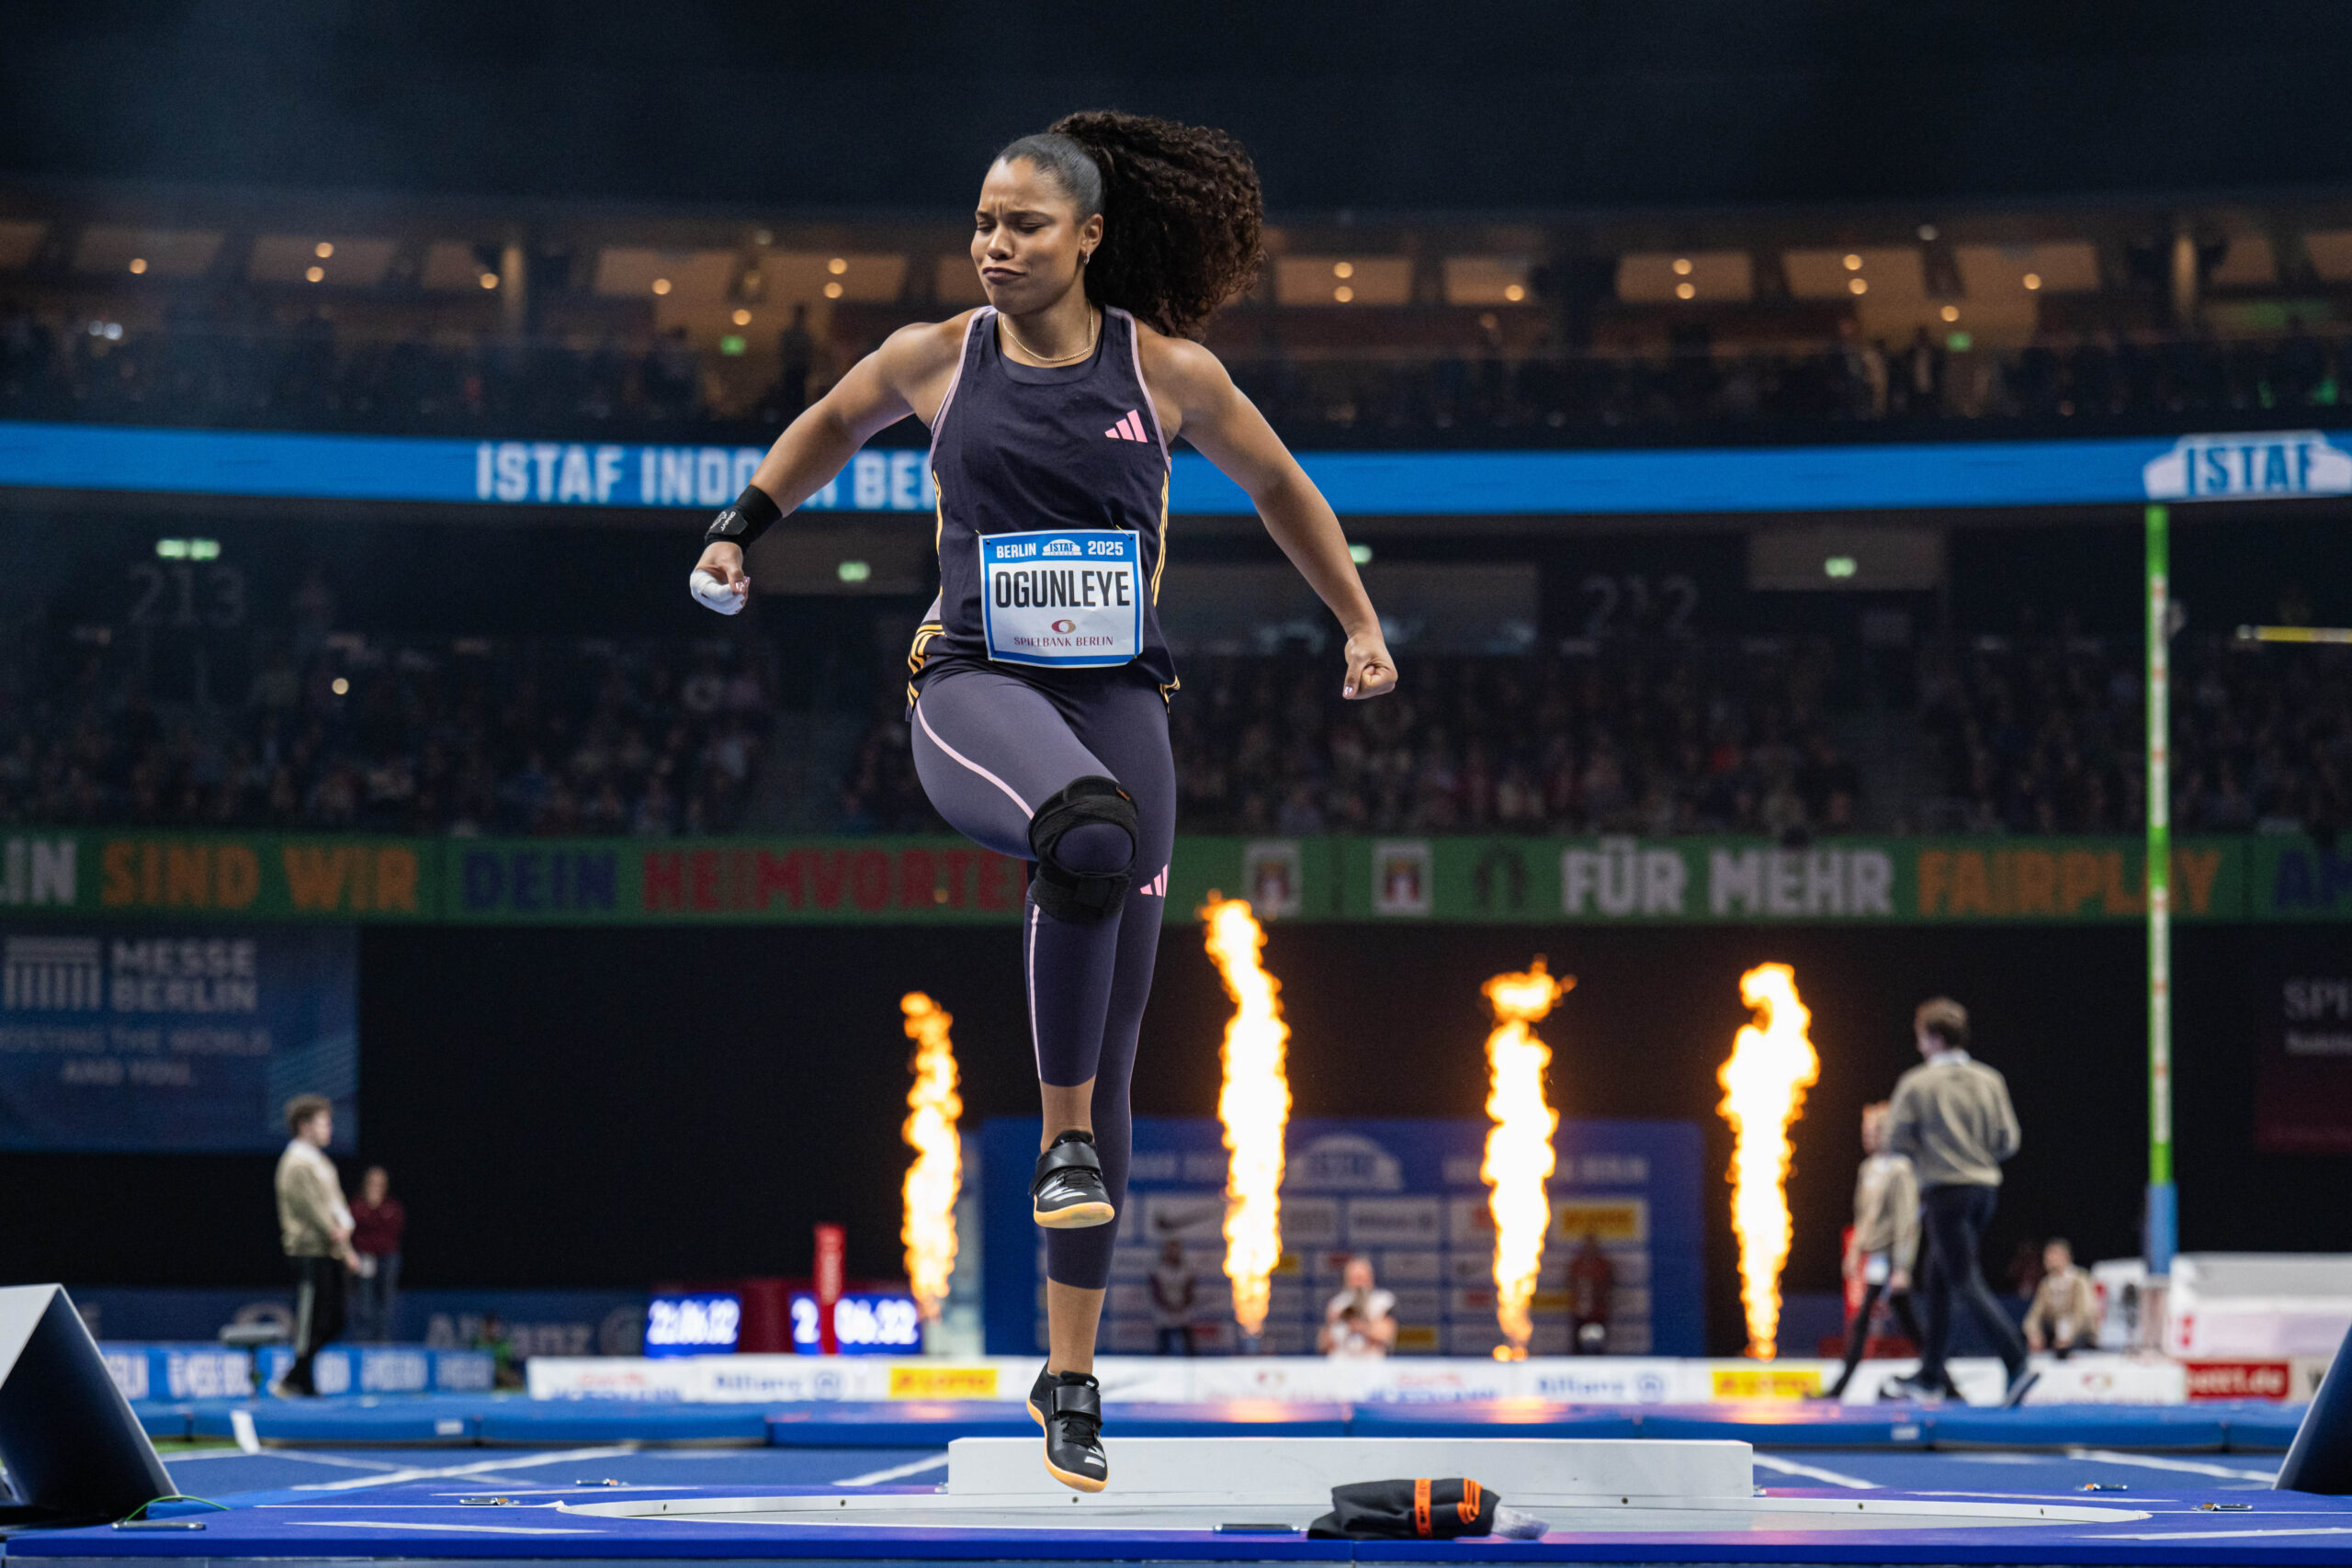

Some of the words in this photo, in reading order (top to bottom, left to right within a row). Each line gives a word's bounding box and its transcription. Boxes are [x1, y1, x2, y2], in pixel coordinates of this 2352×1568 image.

[476, 443, 624, 502] ISTAF
[2187, 445, 2311, 496] ISTAF
[996, 542, 1037, 558] BERLIN
[1087, 540, 1124, 556] 2025
[995, 570, 1130, 608] OGUNLEYE
[1013, 637, 1072, 648] SPIELBANK
[1076, 636, 1114, 647] BERLIN
[102, 840, 261, 909] SIND
[283, 845, 420, 912] WIR
[464, 848, 617, 910] DEIN
[1563, 836, 1688, 917] FÜR
[1710, 848, 1894, 917] MEHR
[112, 938, 256, 976] MESSE
[111, 977, 256, 1011] BERLIN
